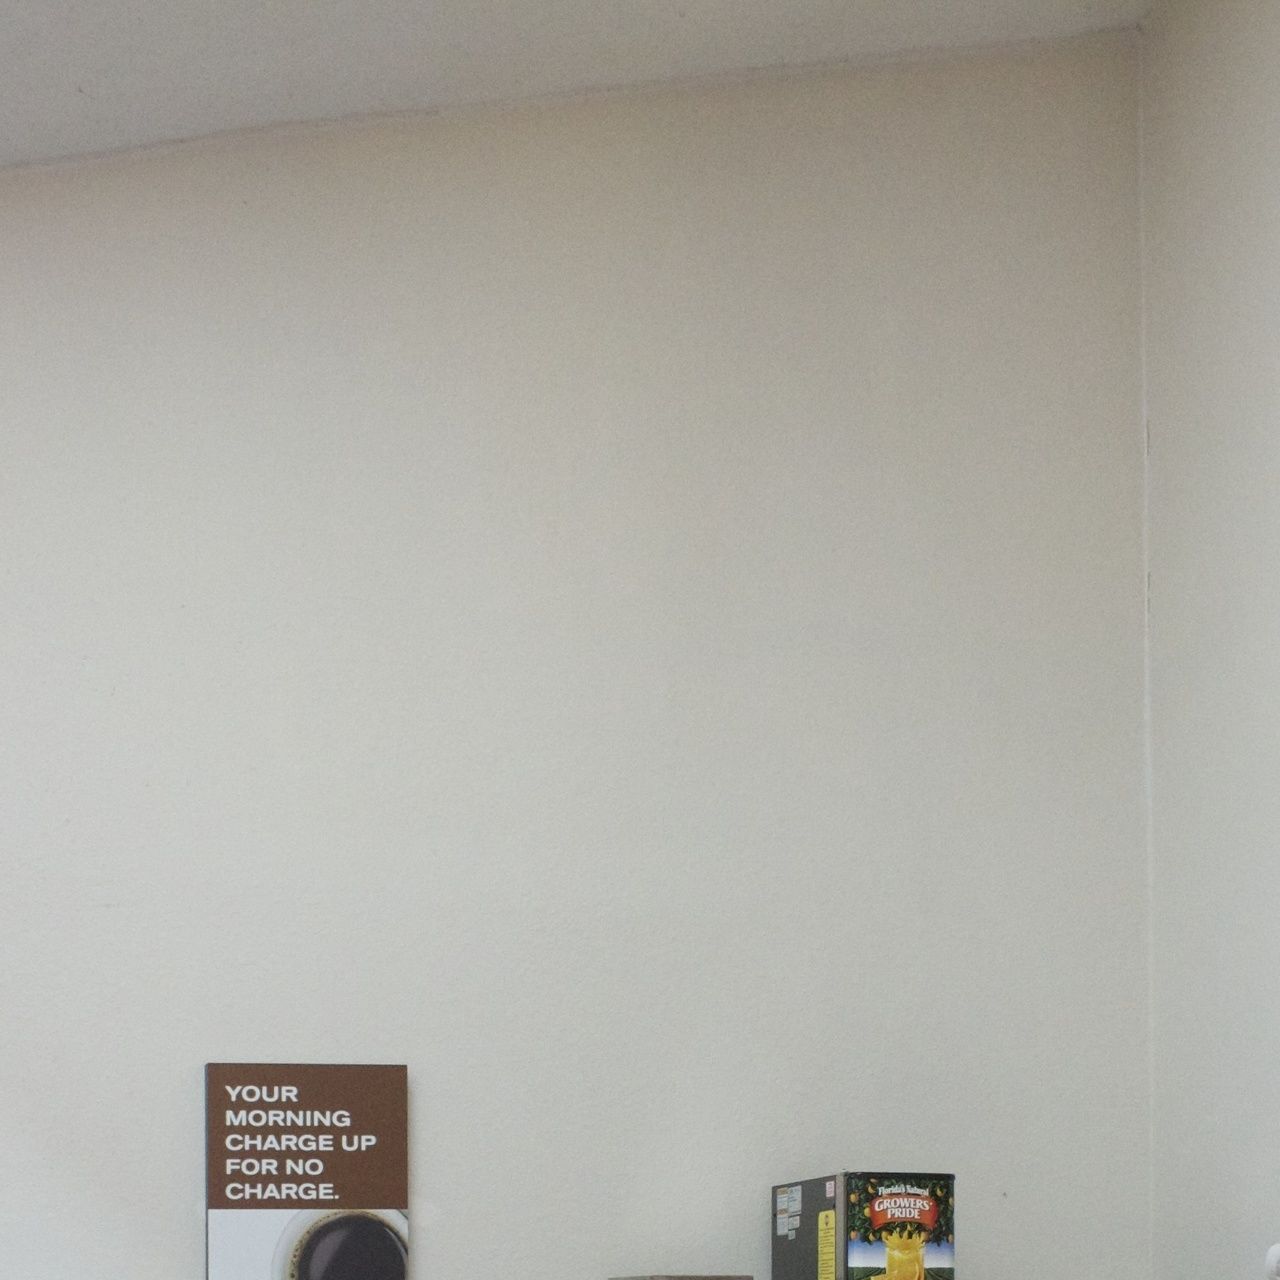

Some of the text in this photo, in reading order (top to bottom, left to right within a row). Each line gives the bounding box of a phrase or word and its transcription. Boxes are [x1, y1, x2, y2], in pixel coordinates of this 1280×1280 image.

[225, 1085, 298, 1102] YOUR
[225, 1110, 351, 1127] MORNING
[225, 1134, 377, 1151] CHARGE UP
[226, 1158, 324, 1175] FOR NO
[225, 1183, 340, 1200] CHARGE.
[887, 1208, 920, 1219] PRIDE
